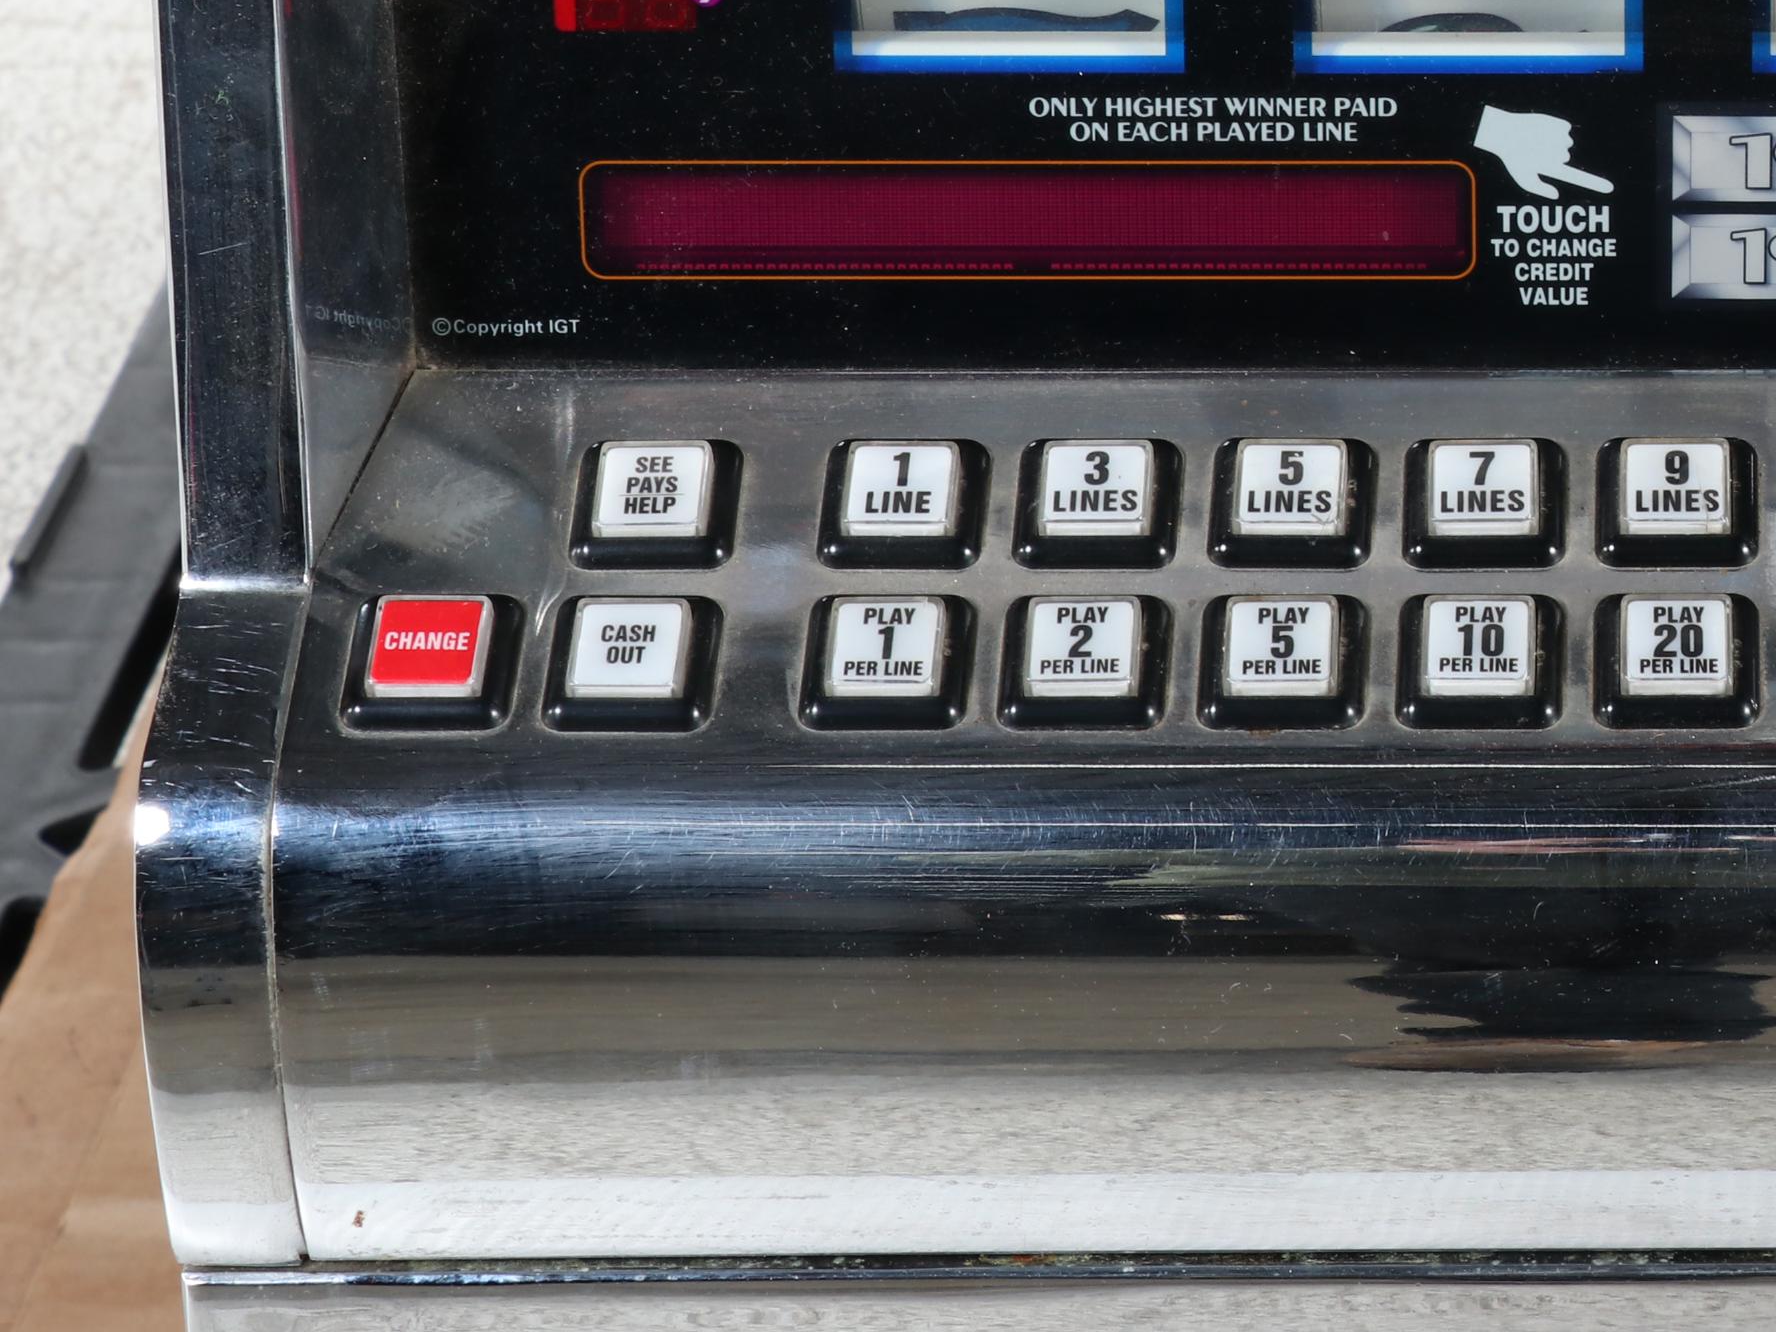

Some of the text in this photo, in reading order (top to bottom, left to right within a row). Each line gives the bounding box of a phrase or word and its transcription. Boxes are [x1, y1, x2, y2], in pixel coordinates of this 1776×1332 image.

[1028, 97, 1398, 118] ONLY HIGHEST WINNER PAID
[1069, 121, 1358, 142] ON EACH PLAYED LINE
[1497, 205, 1610, 234] TOUCH
[1491, 238, 1617, 257] TO CHANGE
[1514, 263, 1594, 281] CREDIT
[1519, 287, 1589, 305] VALUE
[549, 319, 580, 334] IGT
[635, 456, 674, 473] SEE
[893, 452, 911, 486] 1
[1084, 451, 1110, 485] 3
[1278, 451, 1304, 485] 5
[1468, 452, 1495, 485] 7
[1664, 450, 1689, 485] 9
[626, 476, 678, 494] PAYS
[624, 497, 676, 514] HELP
[865, 491, 932, 513] LINE
[1052, 490, 1138, 512] LINES
[1247, 490, 1332, 513] LINES
[1440, 490, 1525, 513] LINES
[1635, 489, 1719, 512] LINES
[863, 608, 916, 625] PLAY
[1057, 606, 1109, 624] PLAY
[1258, 607, 1310, 624] PLAY
[1455, 606, 1507, 623] PLAY
[1653, 606, 1705, 623] PLAY
[384, 631, 470, 651] CHANGE
[601, 624, 656, 643] CASH
[877, 626, 895, 660] 1
[1068, 625, 1094, 658] 2
[1270, 625, 1294, 658] 5
[1457, 623, 1504, 657] 10
[1653, 624, 1704, 658] 20
[606, 646, 646, 664] OUT
[843, 661, 923, 676] PER LINE
[1040, 658, 1120, 675] PER LINE
[1242, 659, 1321, 675] PER LINE
[1439, 657, 1519, 673] PER LINE
[1639, 659, 1719, 674] PER LINE
